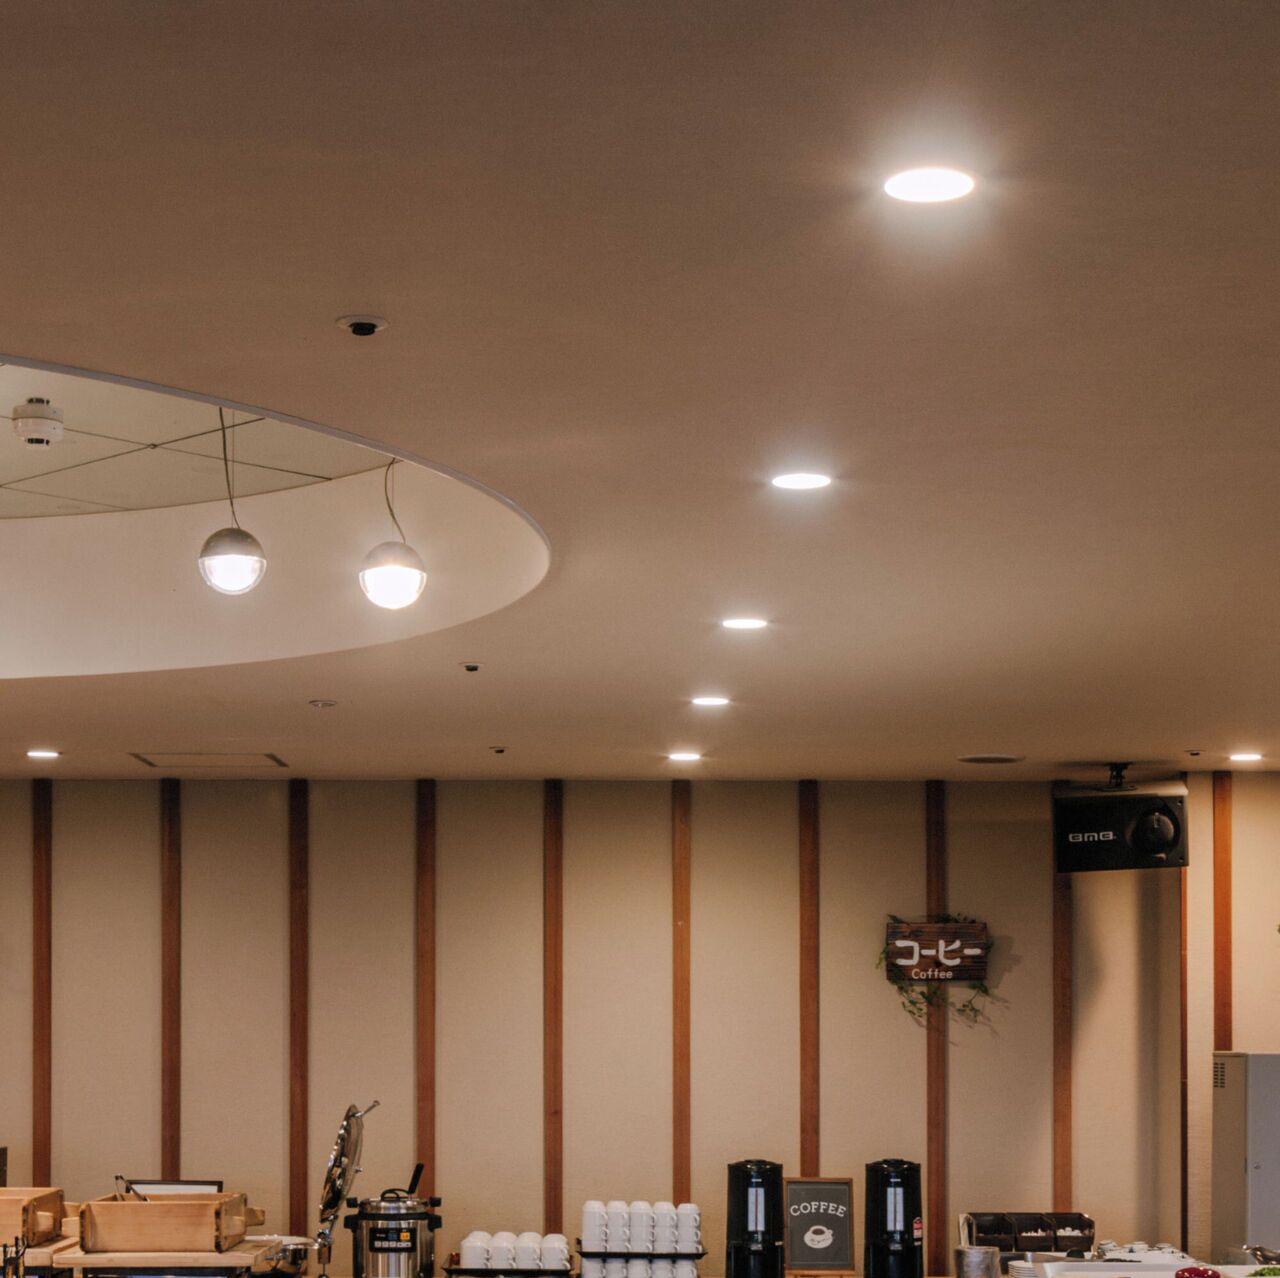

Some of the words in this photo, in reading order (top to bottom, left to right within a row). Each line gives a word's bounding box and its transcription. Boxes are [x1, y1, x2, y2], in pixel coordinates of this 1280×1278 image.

[895, 939, 982, 966] コーヒー
[911, 968, 953, 979] Coffee
[790, 1201, 847, 1218] COFFEE
